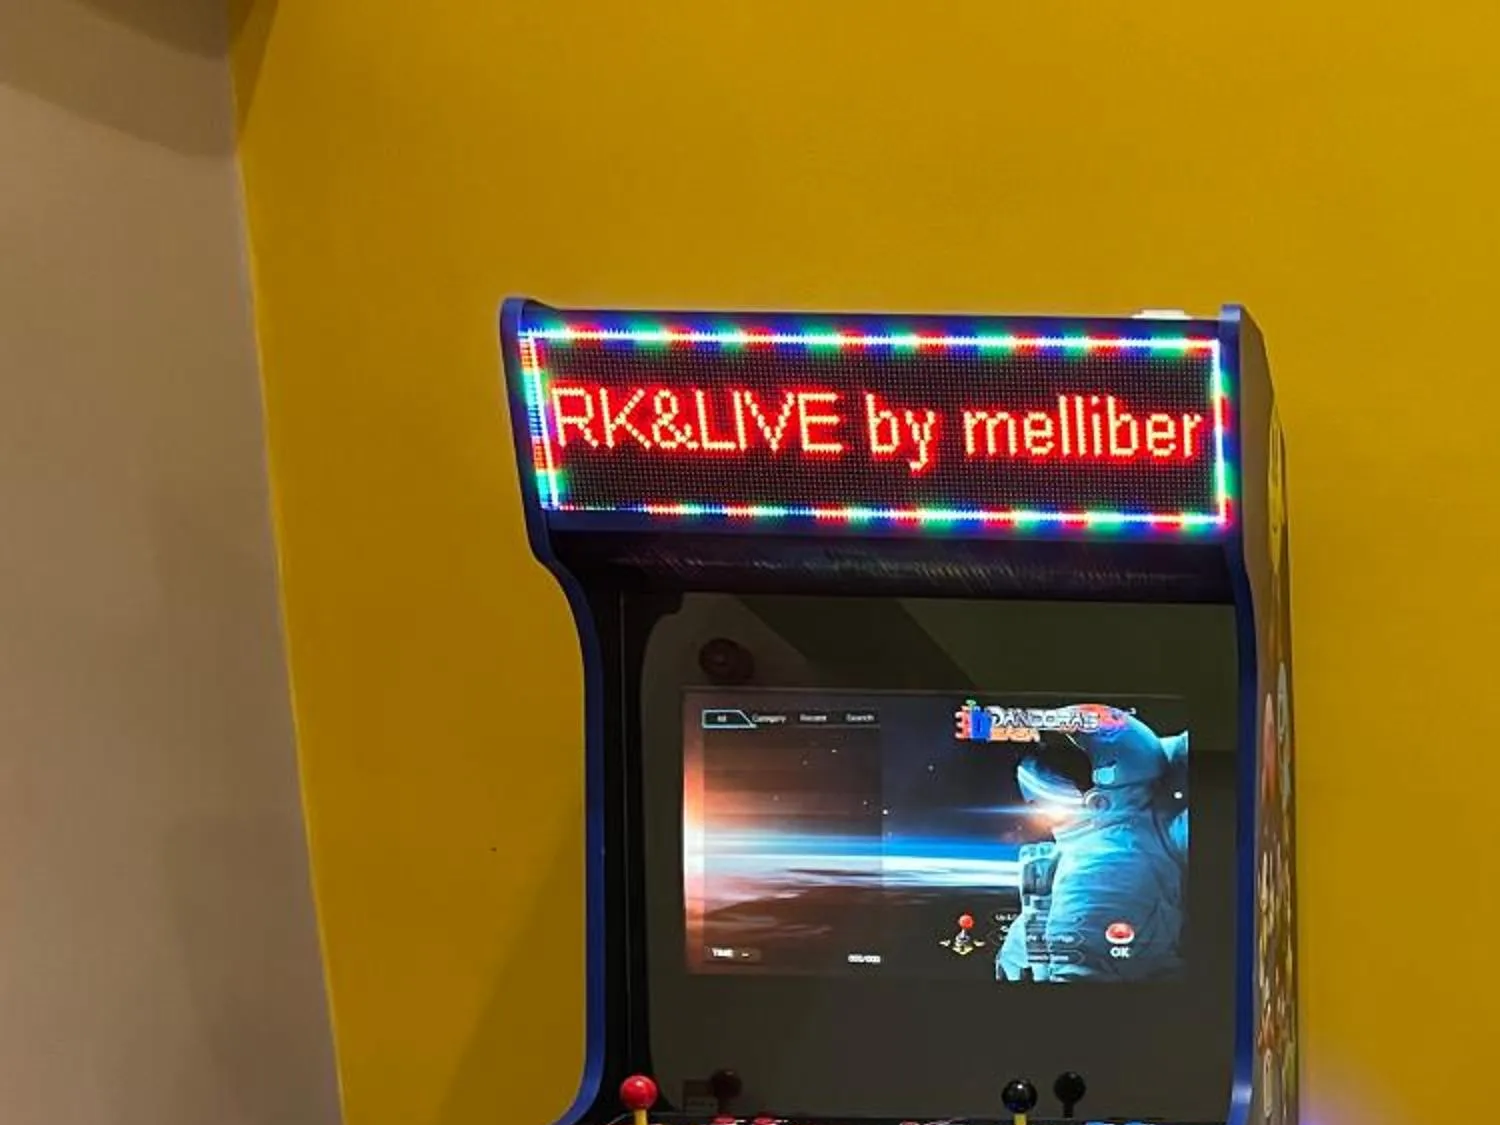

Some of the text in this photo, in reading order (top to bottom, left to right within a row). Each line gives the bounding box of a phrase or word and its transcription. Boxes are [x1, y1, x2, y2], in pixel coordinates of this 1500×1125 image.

[550, 386, 1203, 472] RK&LIVE by melliber
[1109, 946, 1131, 959] OK
